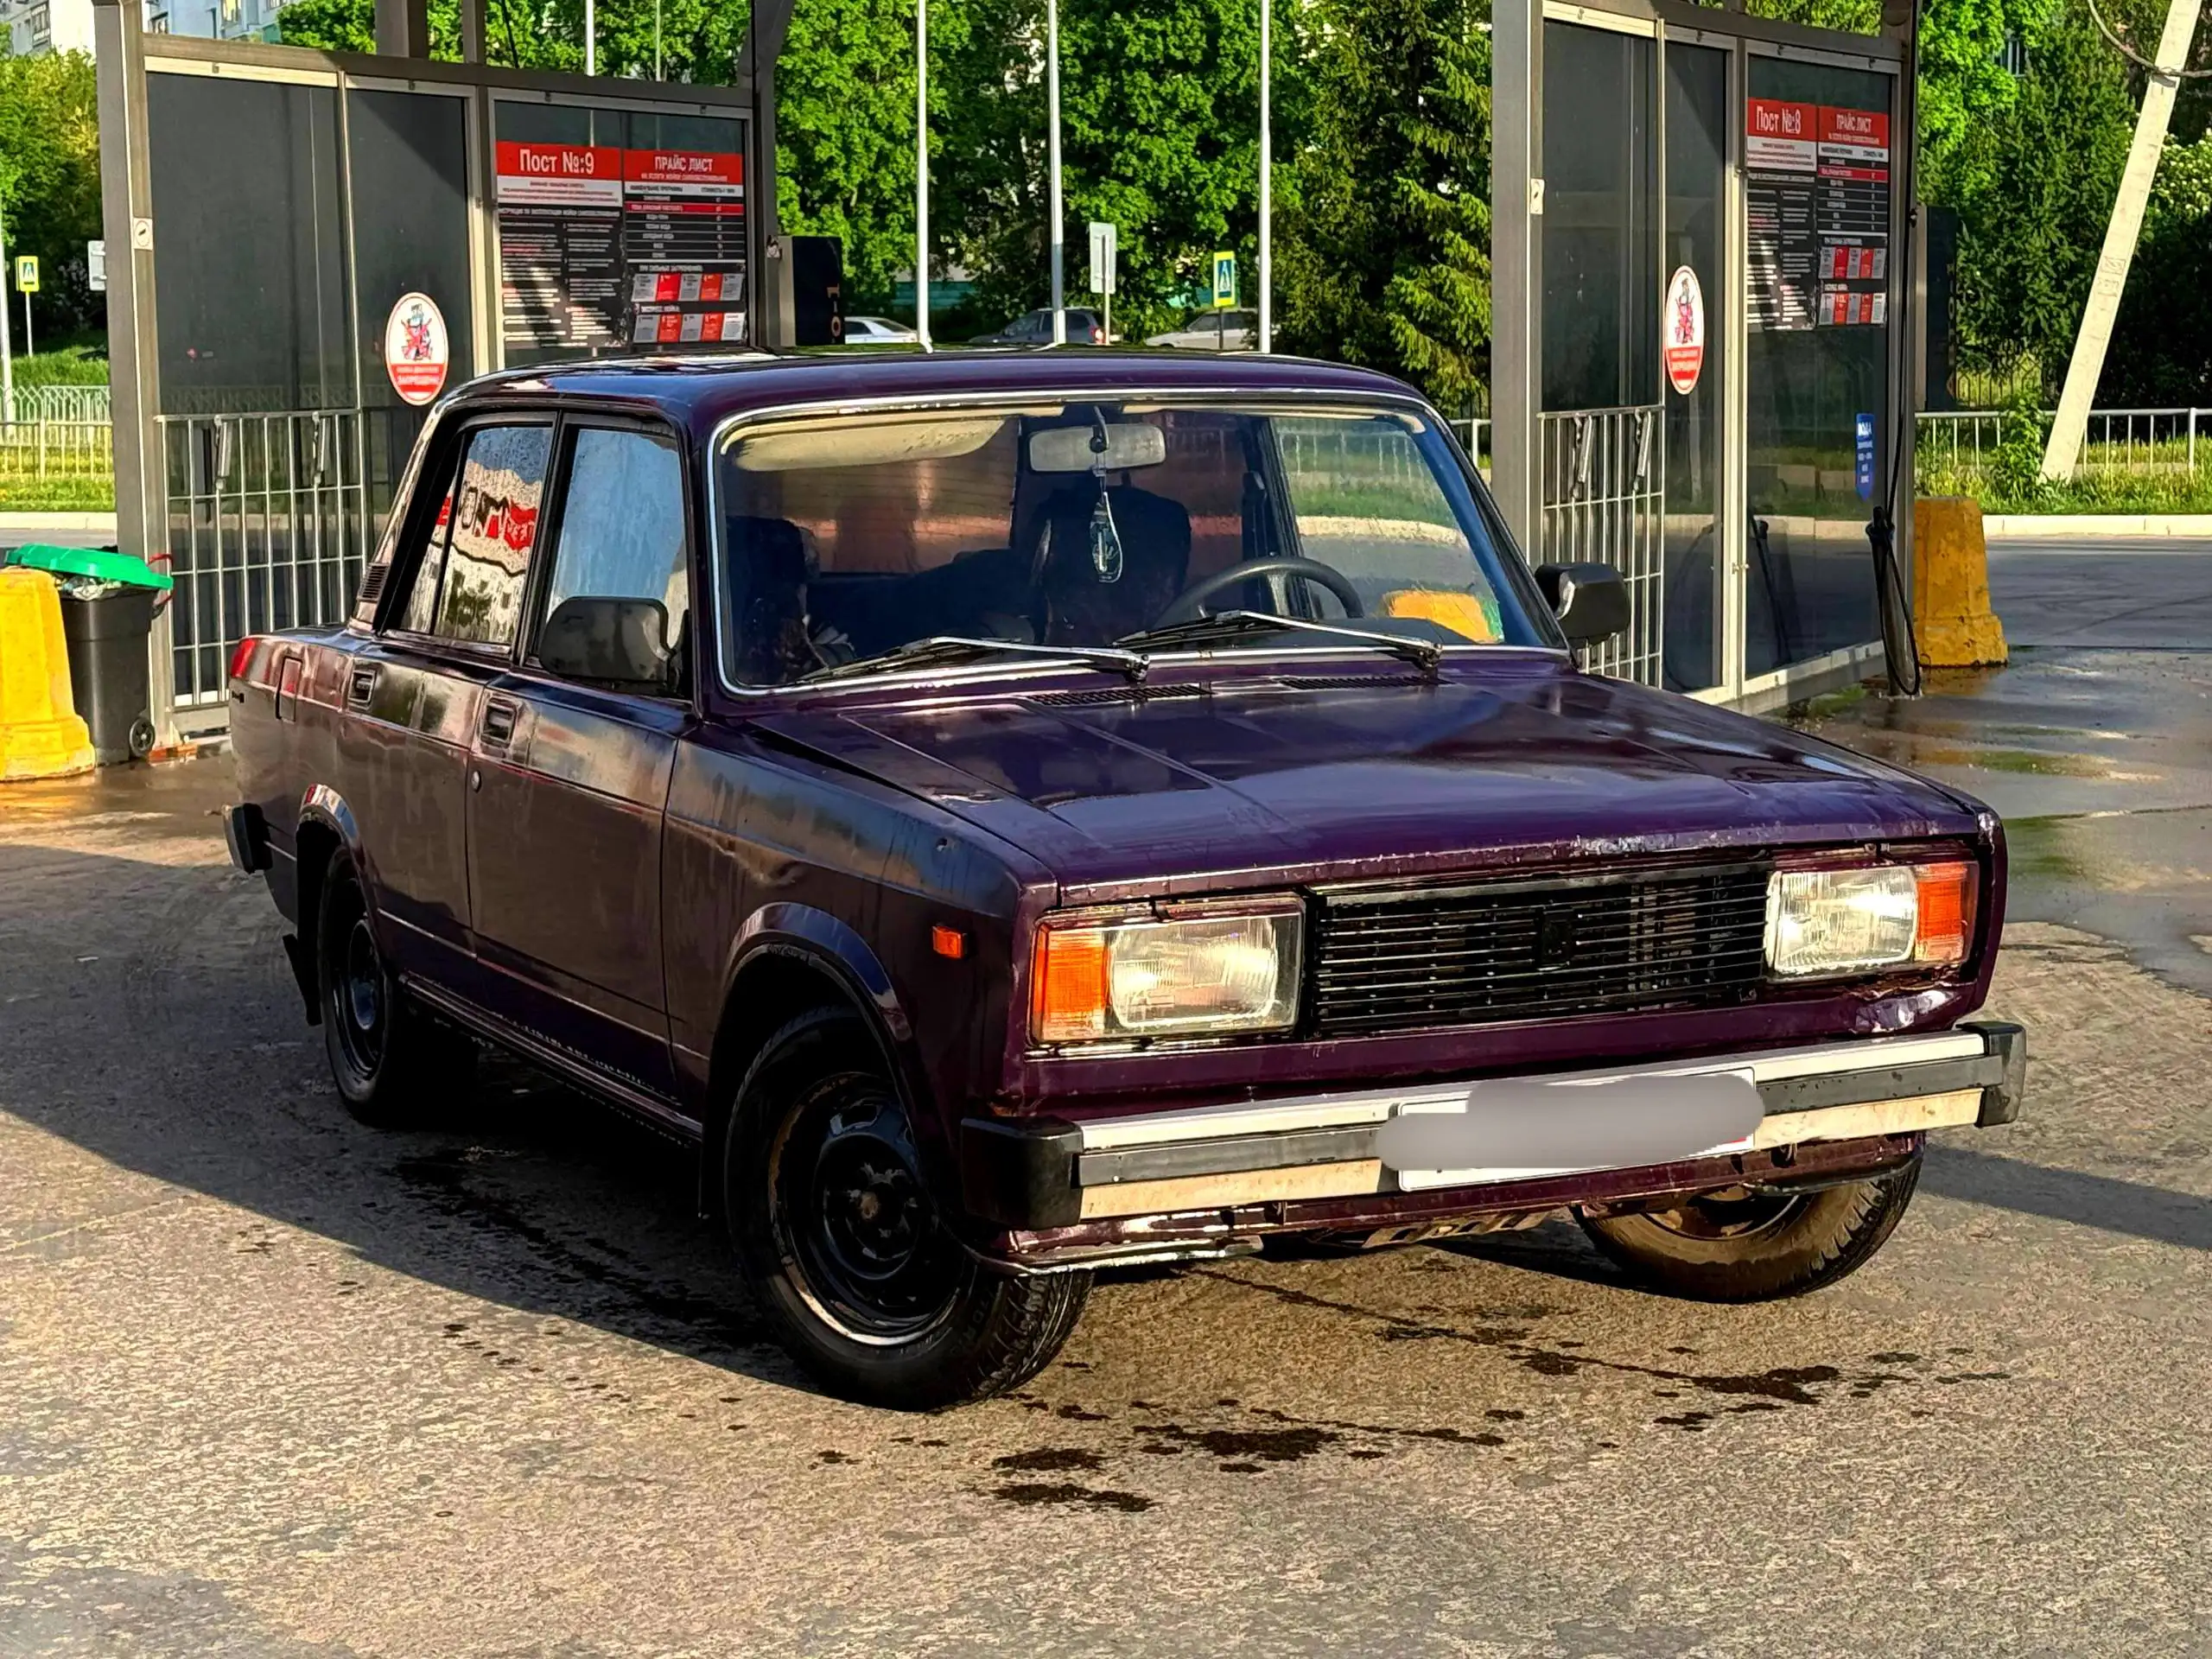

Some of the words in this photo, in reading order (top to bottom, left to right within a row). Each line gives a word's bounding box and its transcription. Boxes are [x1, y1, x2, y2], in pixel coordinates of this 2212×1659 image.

[1757, 105, 1780, 132] Пост
[519, 149, 557, 173] Пост
[654, 155, 687, 172] ПРАЙС
[689, 157, 714, 172] ЛИСТ
